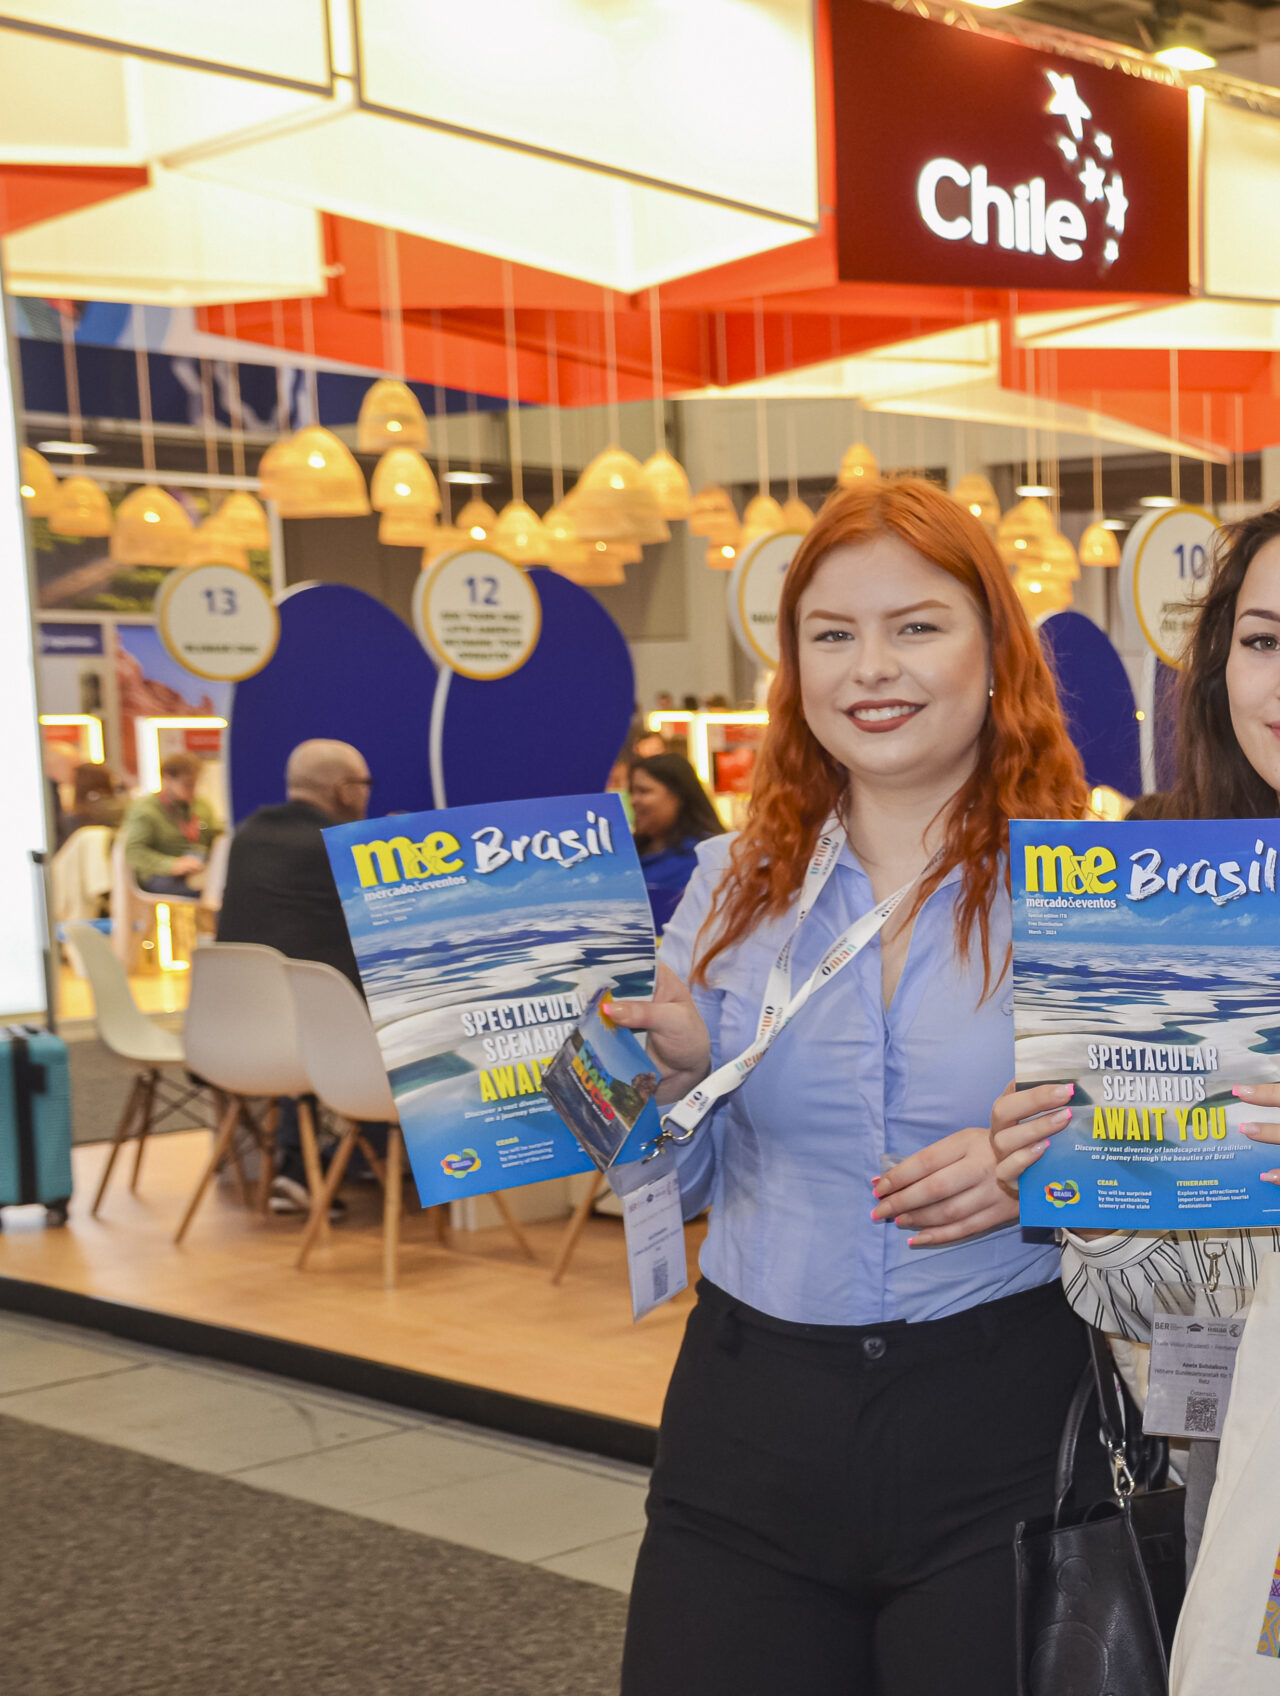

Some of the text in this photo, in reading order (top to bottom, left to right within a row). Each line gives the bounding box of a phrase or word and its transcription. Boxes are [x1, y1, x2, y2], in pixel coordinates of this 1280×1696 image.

[917, 157, 1087, 262] Chile
[1173, 544, 1206, 580] 10
[204, 588, 238, 616] 13
[465, 577, 499, 606] 12
[351, 810, 614, 888] m&e Brasil
[1024, 839, 1277, 906] m&e Brasil
[363, 876, 467, 902] mercado&eventos
[1026, 896, 1117, 909] mercado&eventos
[1087, 1044, 1218, 1071] SPECTACULAR
[1102, 1075, 1206, 1101] SCENARIOS
[1092, 1106, 1227, 1141] AWAIT YOU
[1075, 1144, 1103, 1152] Discover
[1124, 1145, 1154, 1154] diversity
[1163, 1146, 1201, 1154] landscapes
[1217, 1143, 1252, 1152] traditions
[1105, 1154, 1131, 1162] journey
[1132, 1154, 1159, 1163] through
[1173, 1154, 1203, 1162] beauties
[1214, 1152, 1235, 1160] Brazil
[1097, 1178, 1118, 1186] CEARÁ
[1176, 1179, 1219, 1187] ITINERARIES
[1154, 1322, 1170, 1331] BER
